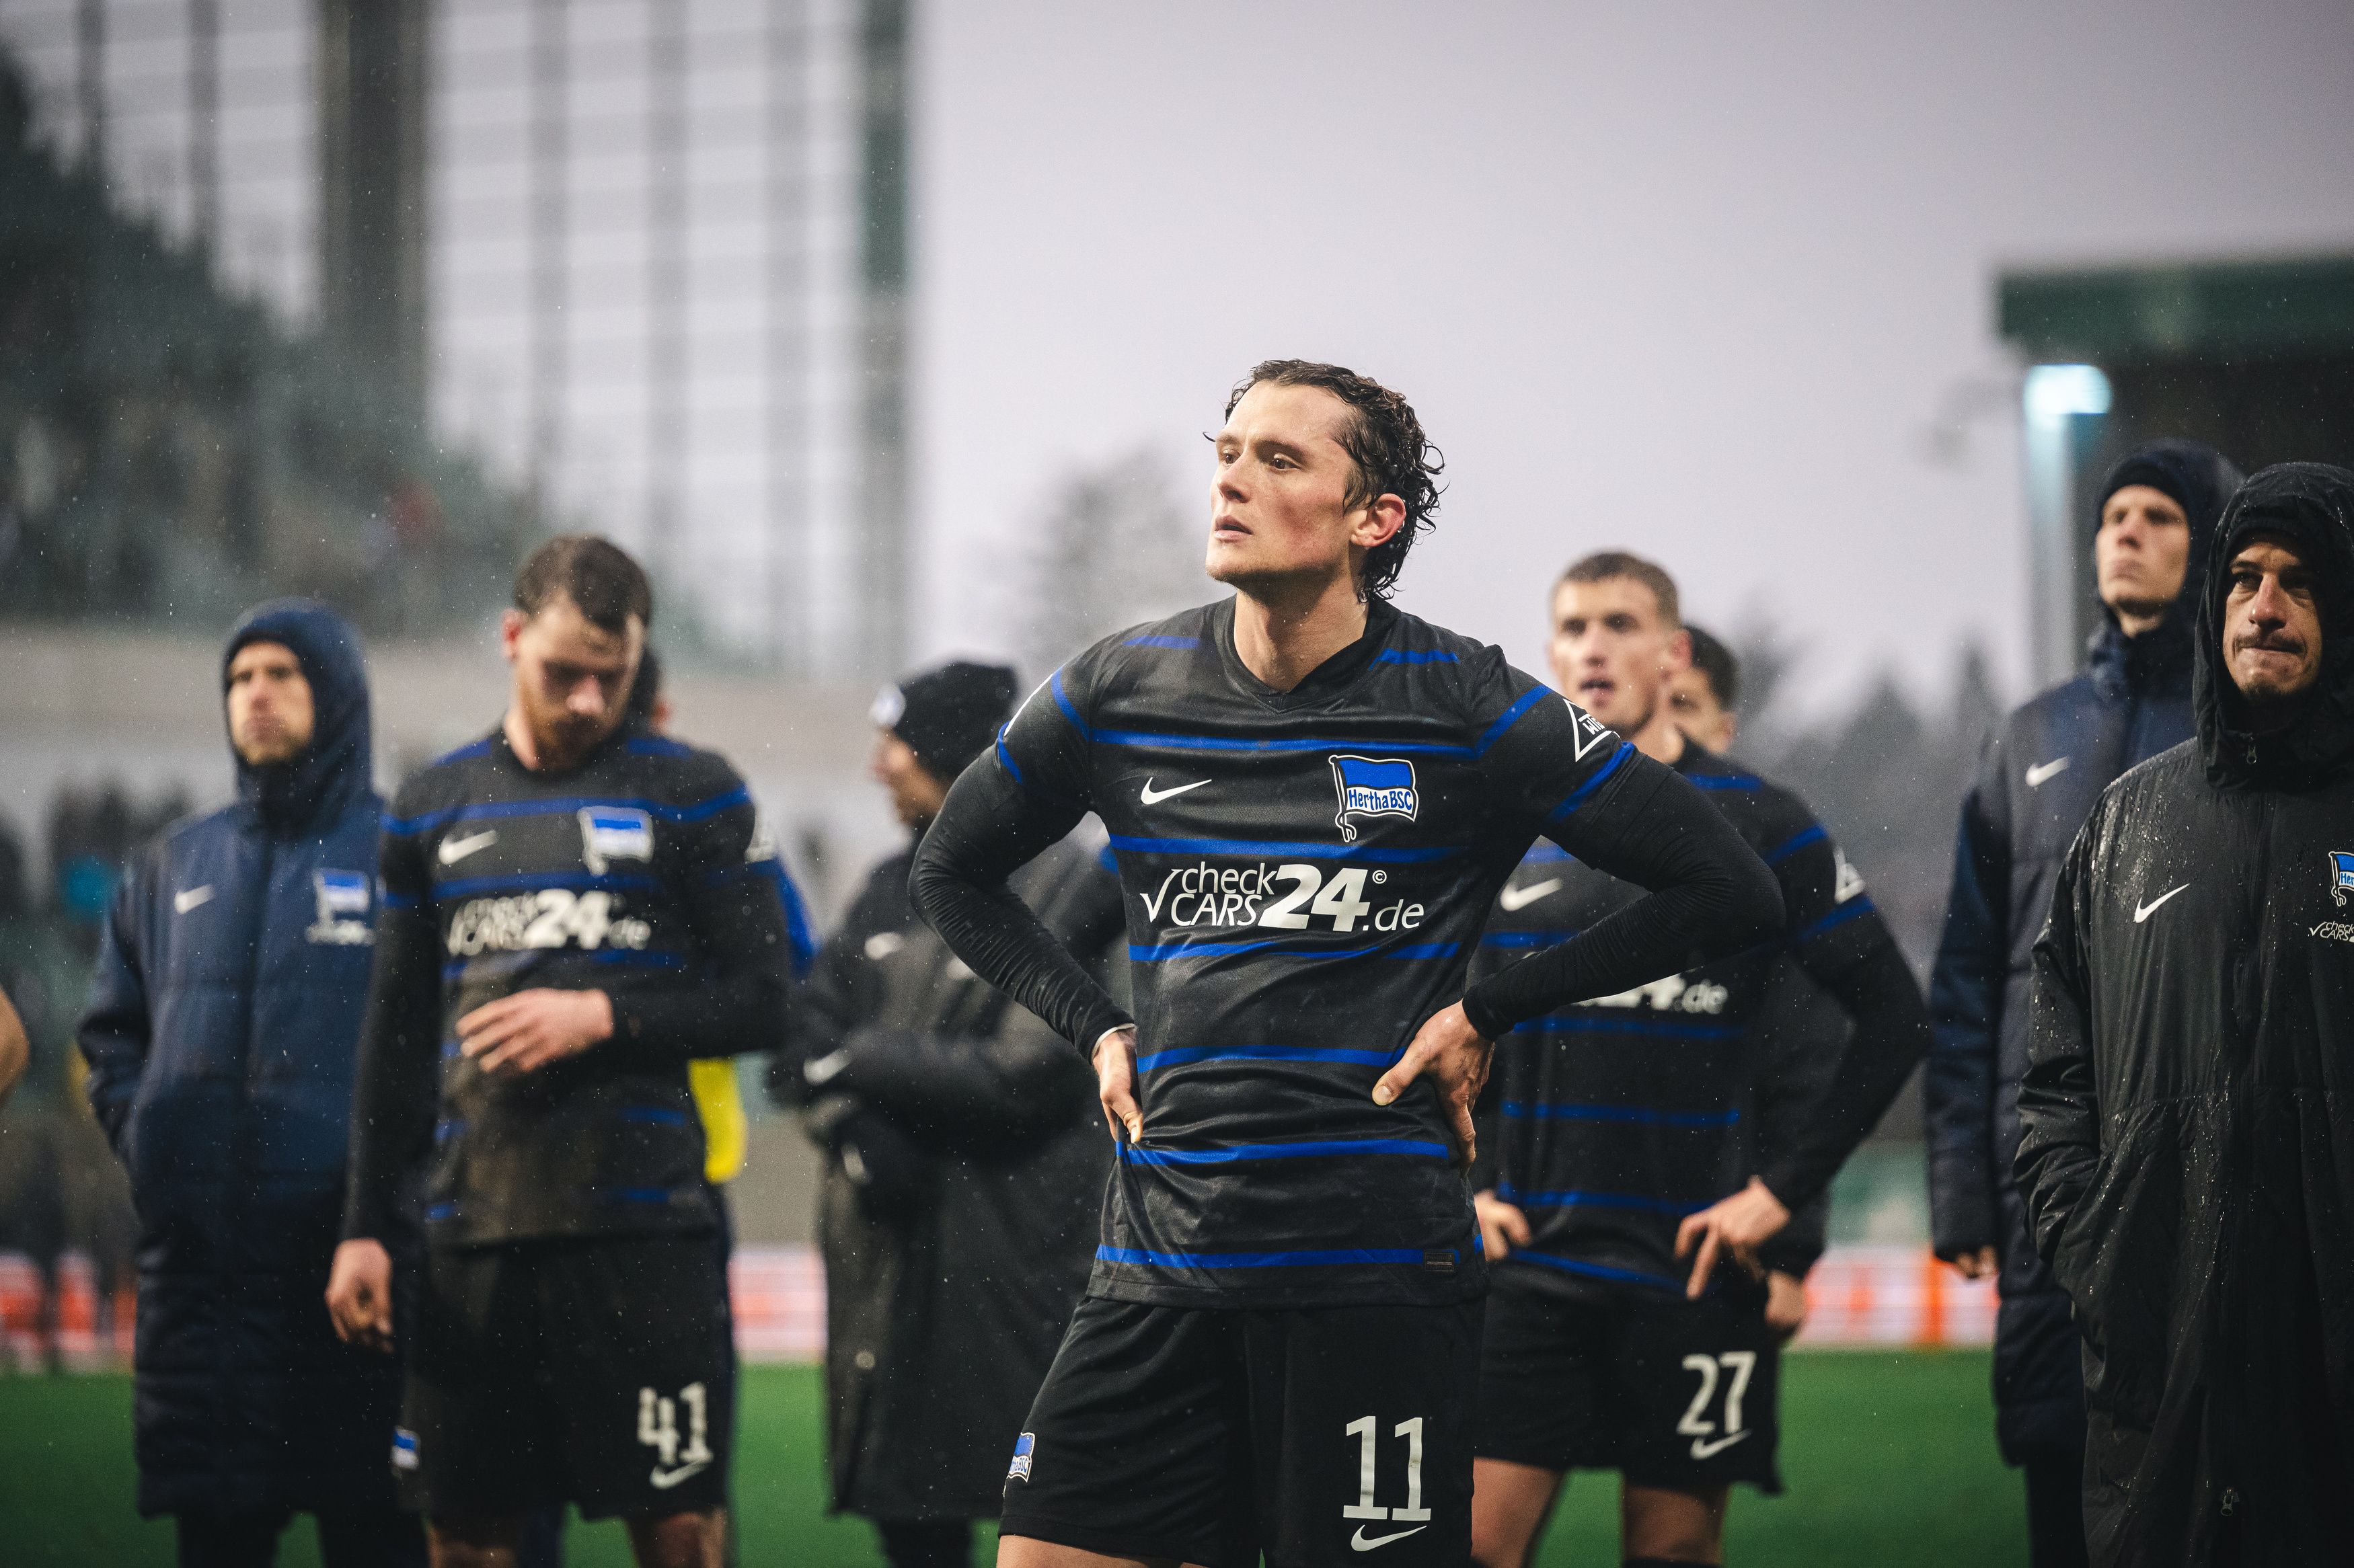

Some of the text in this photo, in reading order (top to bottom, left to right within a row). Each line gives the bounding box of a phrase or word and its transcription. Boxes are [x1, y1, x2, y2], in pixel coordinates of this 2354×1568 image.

[1182, 861, 1277, 895] check
[1171, 893, 1262, 927] CARS
[2320, 928, 2349, 941] CARS
[1676, 1350, 1757, 1435] 27
[636, 1382, 714, 1466] 41
[1343, 1415, 1431, 1521] 11
